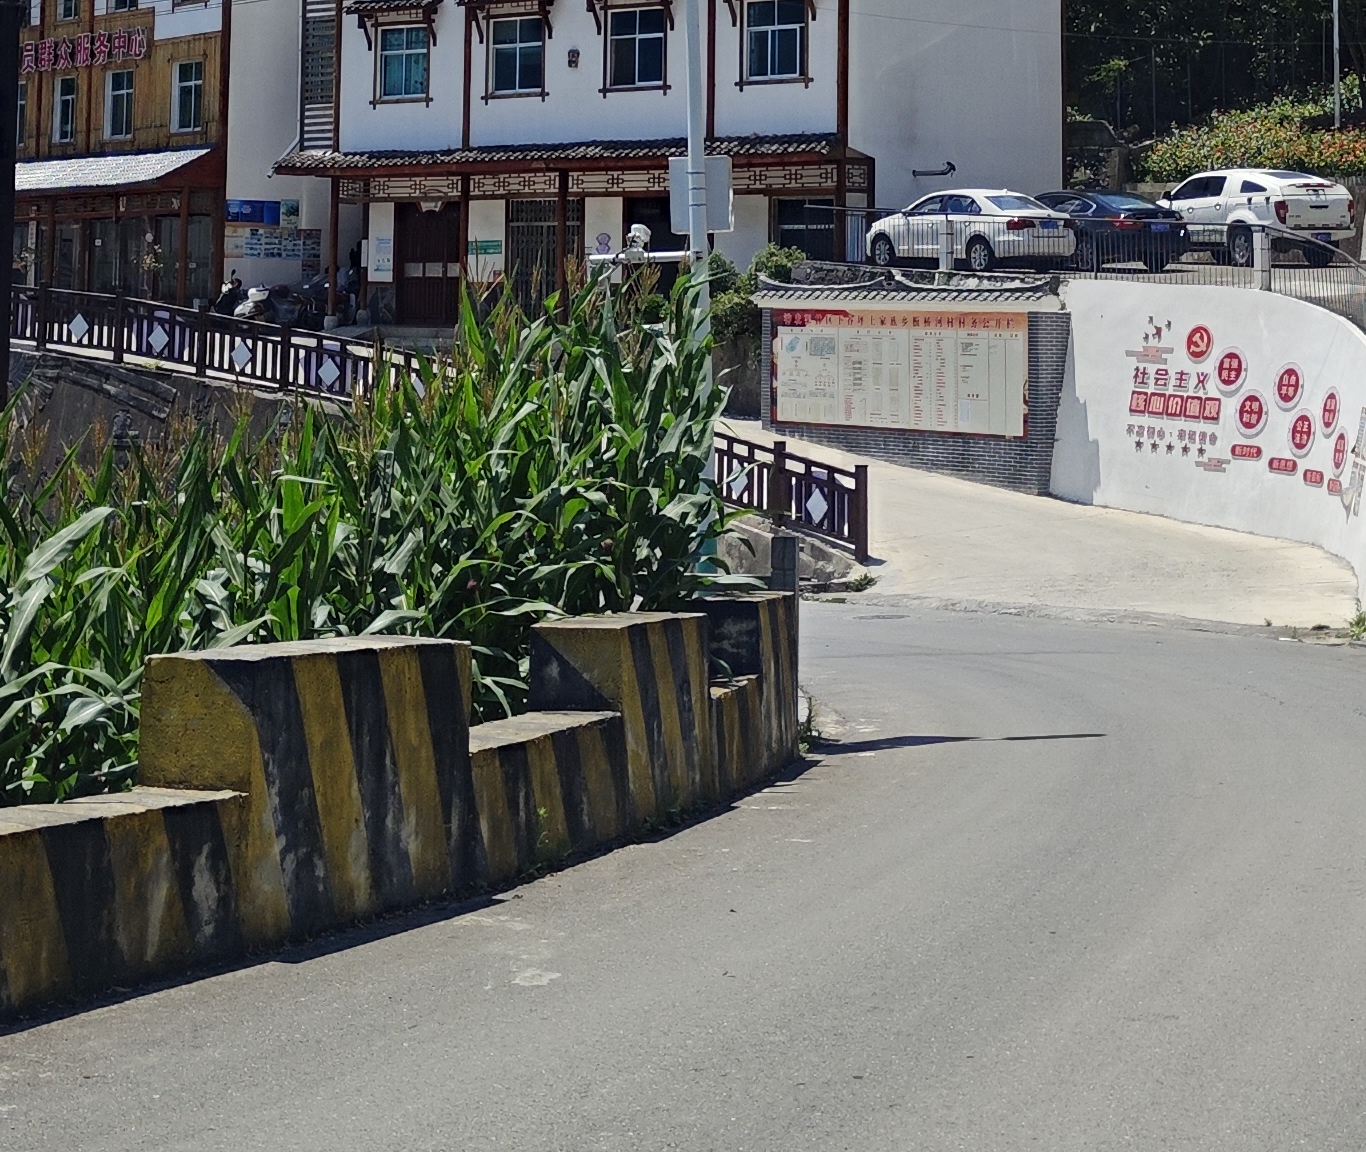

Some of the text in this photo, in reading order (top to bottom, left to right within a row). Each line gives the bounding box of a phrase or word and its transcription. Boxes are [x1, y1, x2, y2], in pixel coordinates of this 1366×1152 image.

[20, 25, 147, 75] 员群众服务中心
[1132, 365, 1209, 390] 社会主义
[1130, 393, 1220, 418] 核心价值观
[1234, 445, 1258, 458] 新时代
